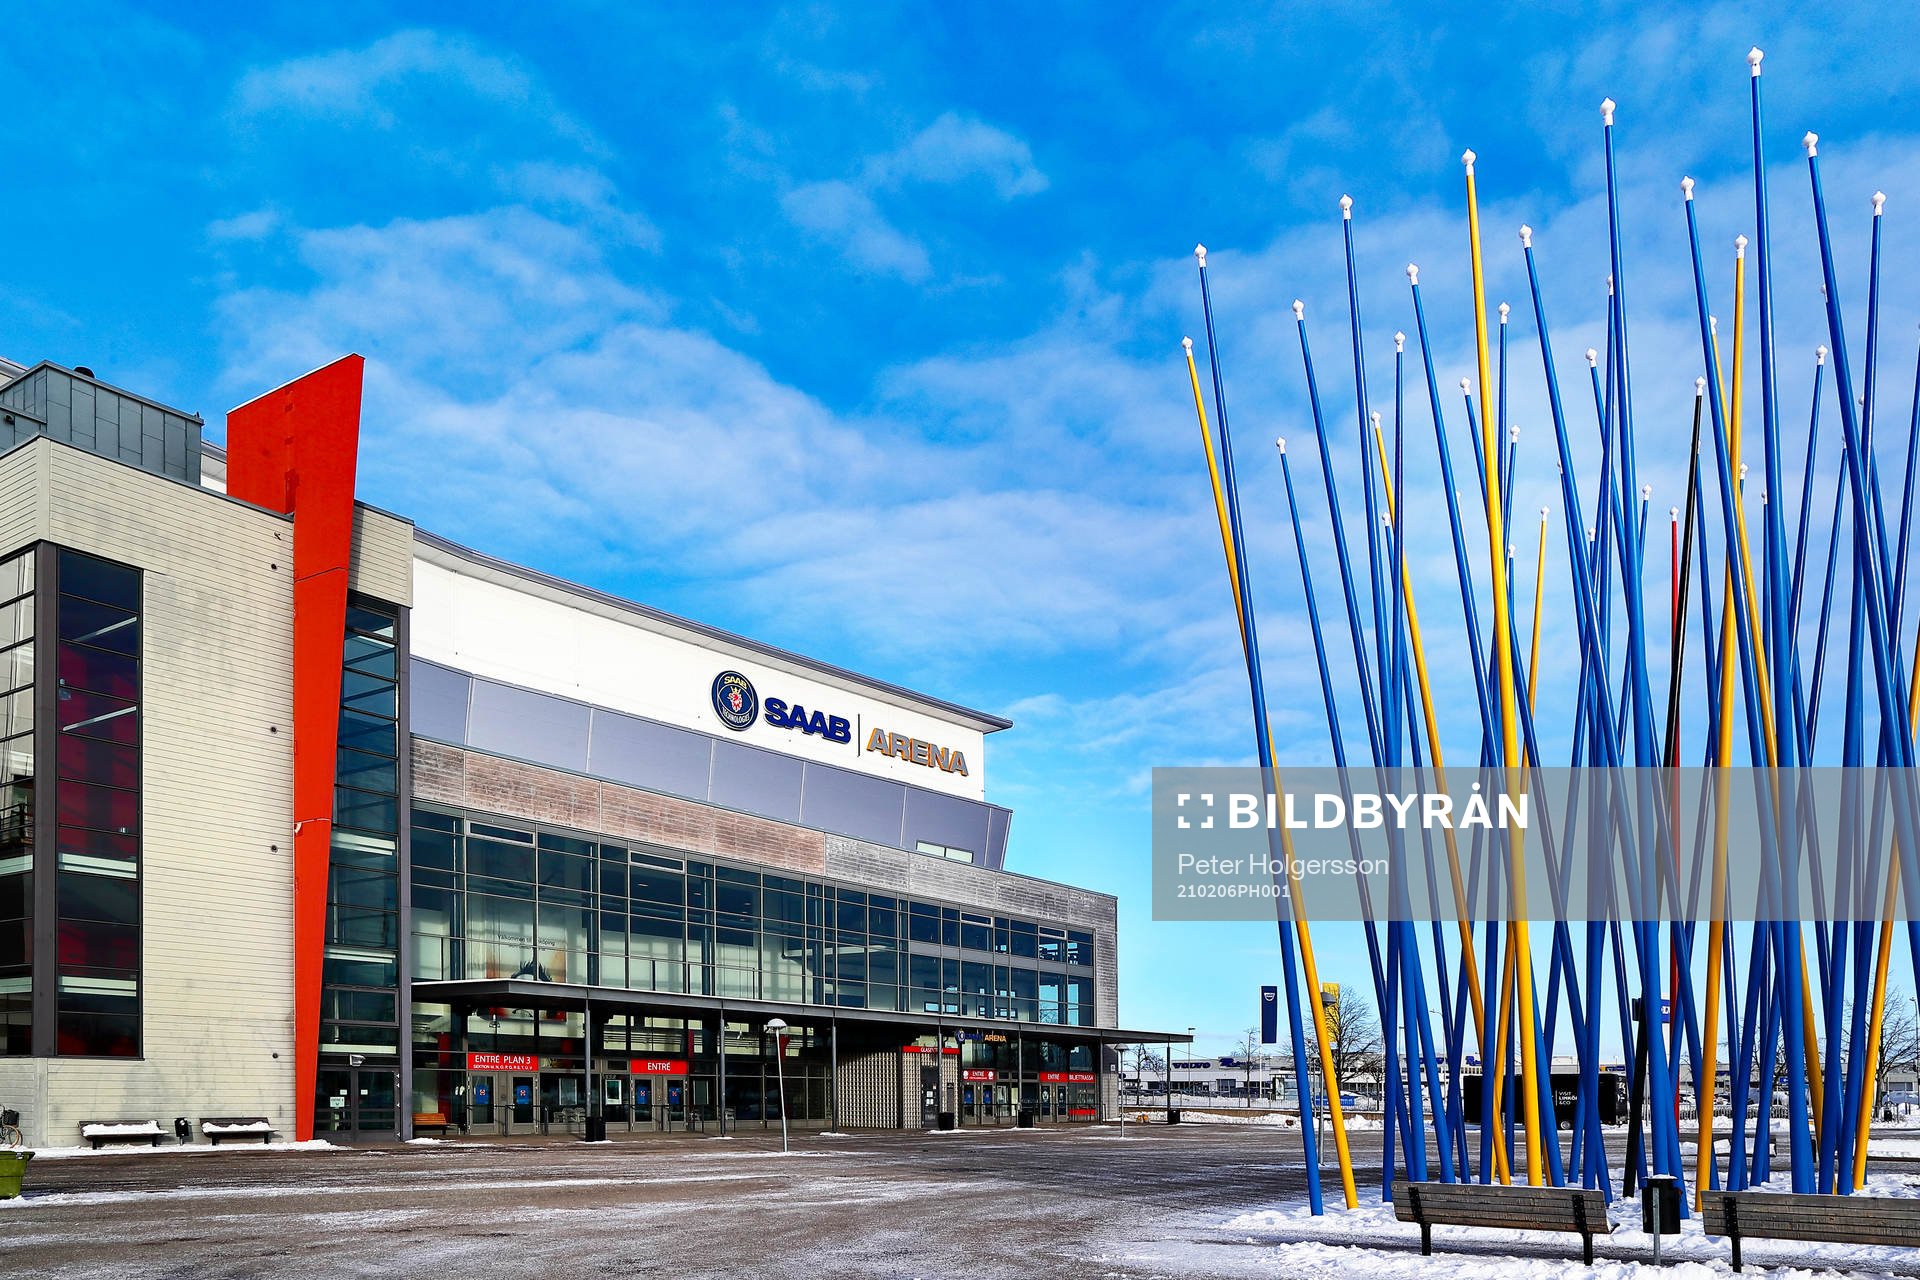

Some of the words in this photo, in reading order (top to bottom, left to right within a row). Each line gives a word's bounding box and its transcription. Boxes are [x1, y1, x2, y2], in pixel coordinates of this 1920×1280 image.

[724, 676, 748, 689] SAAB
[764, 697, 851, 745] SAAB
[866, 727, 969, 777] ARENA
[984, 1034, 1007, 1042] ARENA
[475, 1055, 500, 1063] ENTRÉ
[504, 1056, 524, 1064] PLAN
[647, 1062, 670, 1071] ENTRÉ
